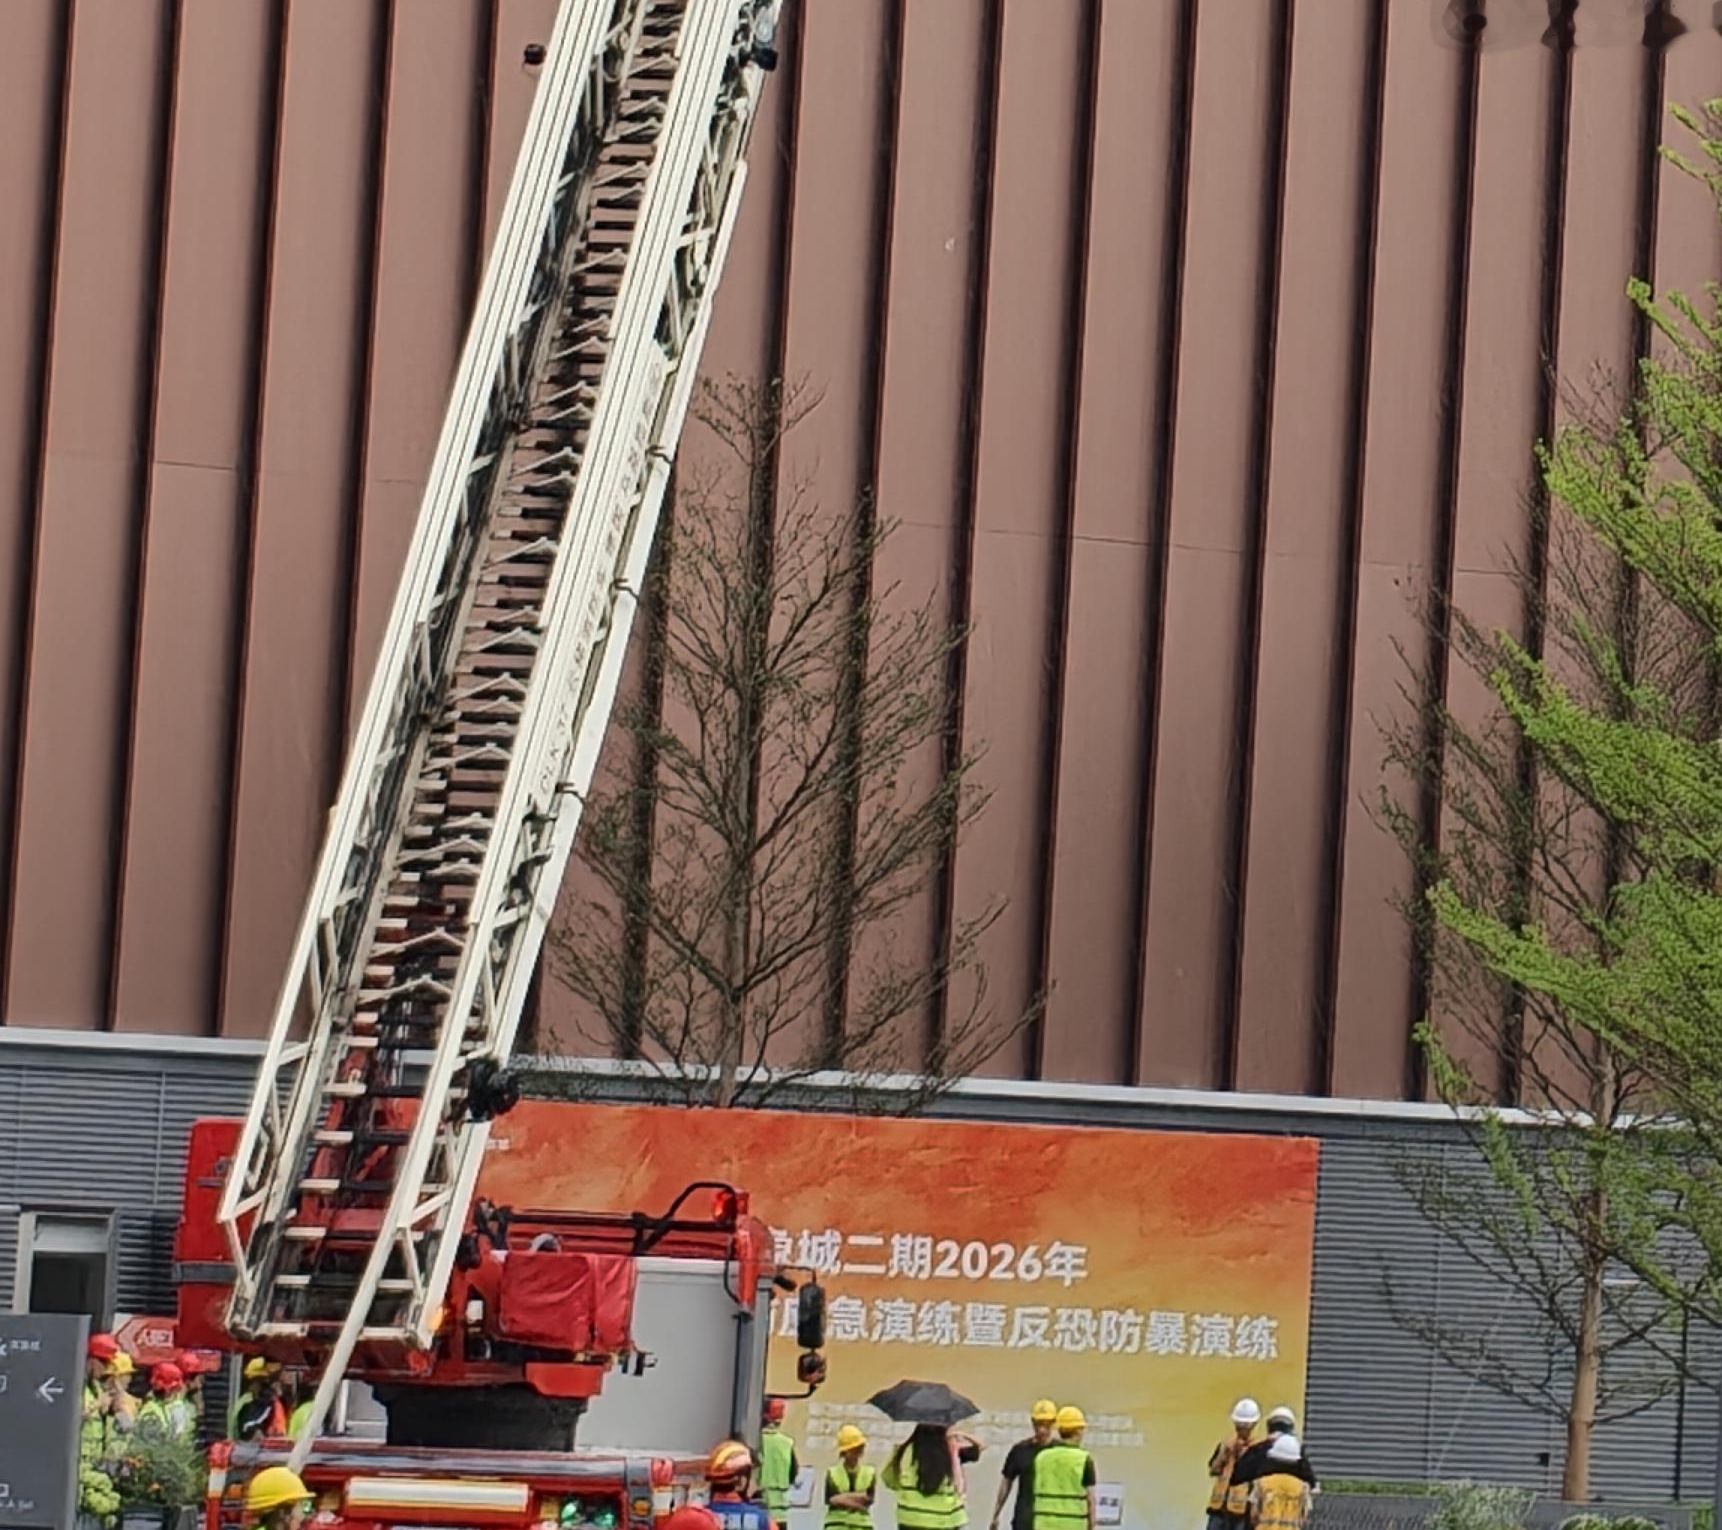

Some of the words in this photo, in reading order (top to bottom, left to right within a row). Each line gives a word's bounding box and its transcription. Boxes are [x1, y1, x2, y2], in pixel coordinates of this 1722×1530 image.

[770, 1294, 1279, 1361] 急演练暨反恐防暴演练
